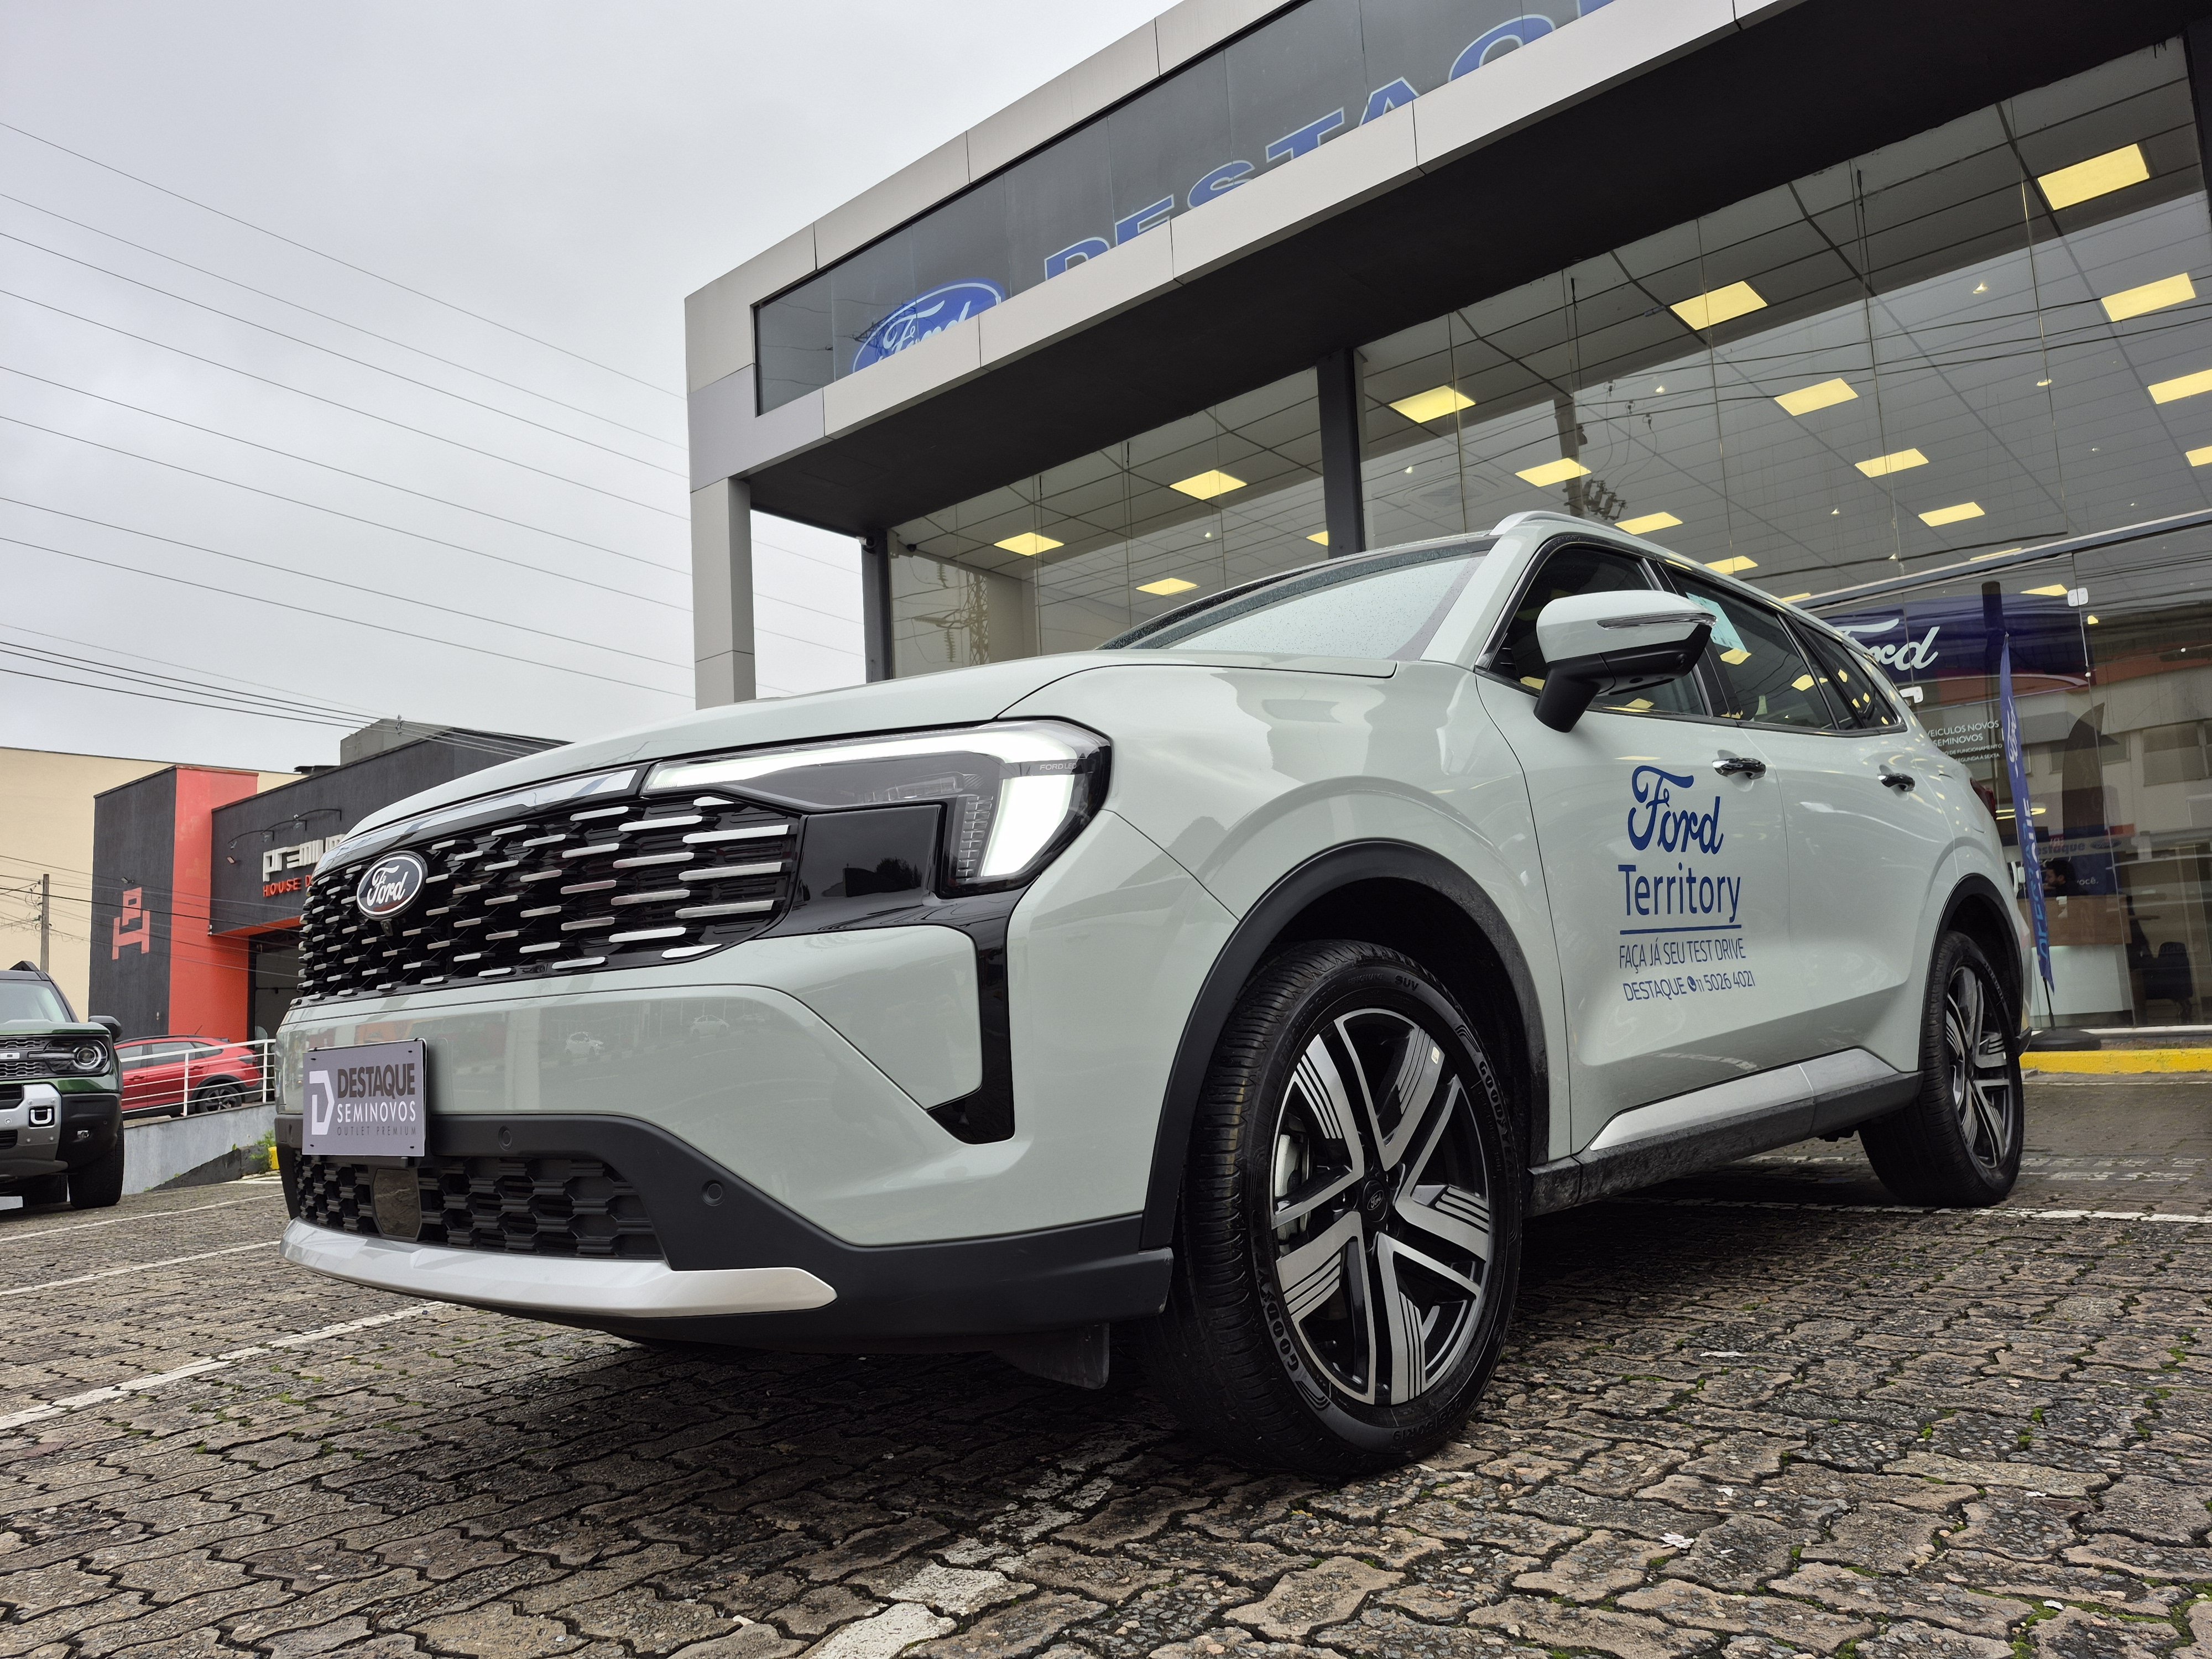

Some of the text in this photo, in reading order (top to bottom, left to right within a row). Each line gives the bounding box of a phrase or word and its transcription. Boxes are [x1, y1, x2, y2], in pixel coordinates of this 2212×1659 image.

[1968, 720, 1999, 732] NOVOS
[1627, 765, 1724, 854] Ford
[2038, 842, 2085, 854] estaque
[263, 878, 302, 897] HOUSE
[367, 865, 408, 906] Ford
[1618, 862, 1741, 923] Territory
[2077, 877, 2099, 885] ocê.
[1620, 937, 1746, 974] FAÇA JÁ SEU TEST DRIVE
[1395, 975, 1419, 992] SUV
[1623, 977, 1687, 1001] DESTAQUE
[1703, 973, 1732, 992] 5026
[1733, 971, 1756, 988] 4021
[337, 1063, 415, 1099] DESTAQUE
[337, 1100, 416, 1123] SEMINOVOS
[337, 1125, 416, 1136] OUTLET PREMIUM
